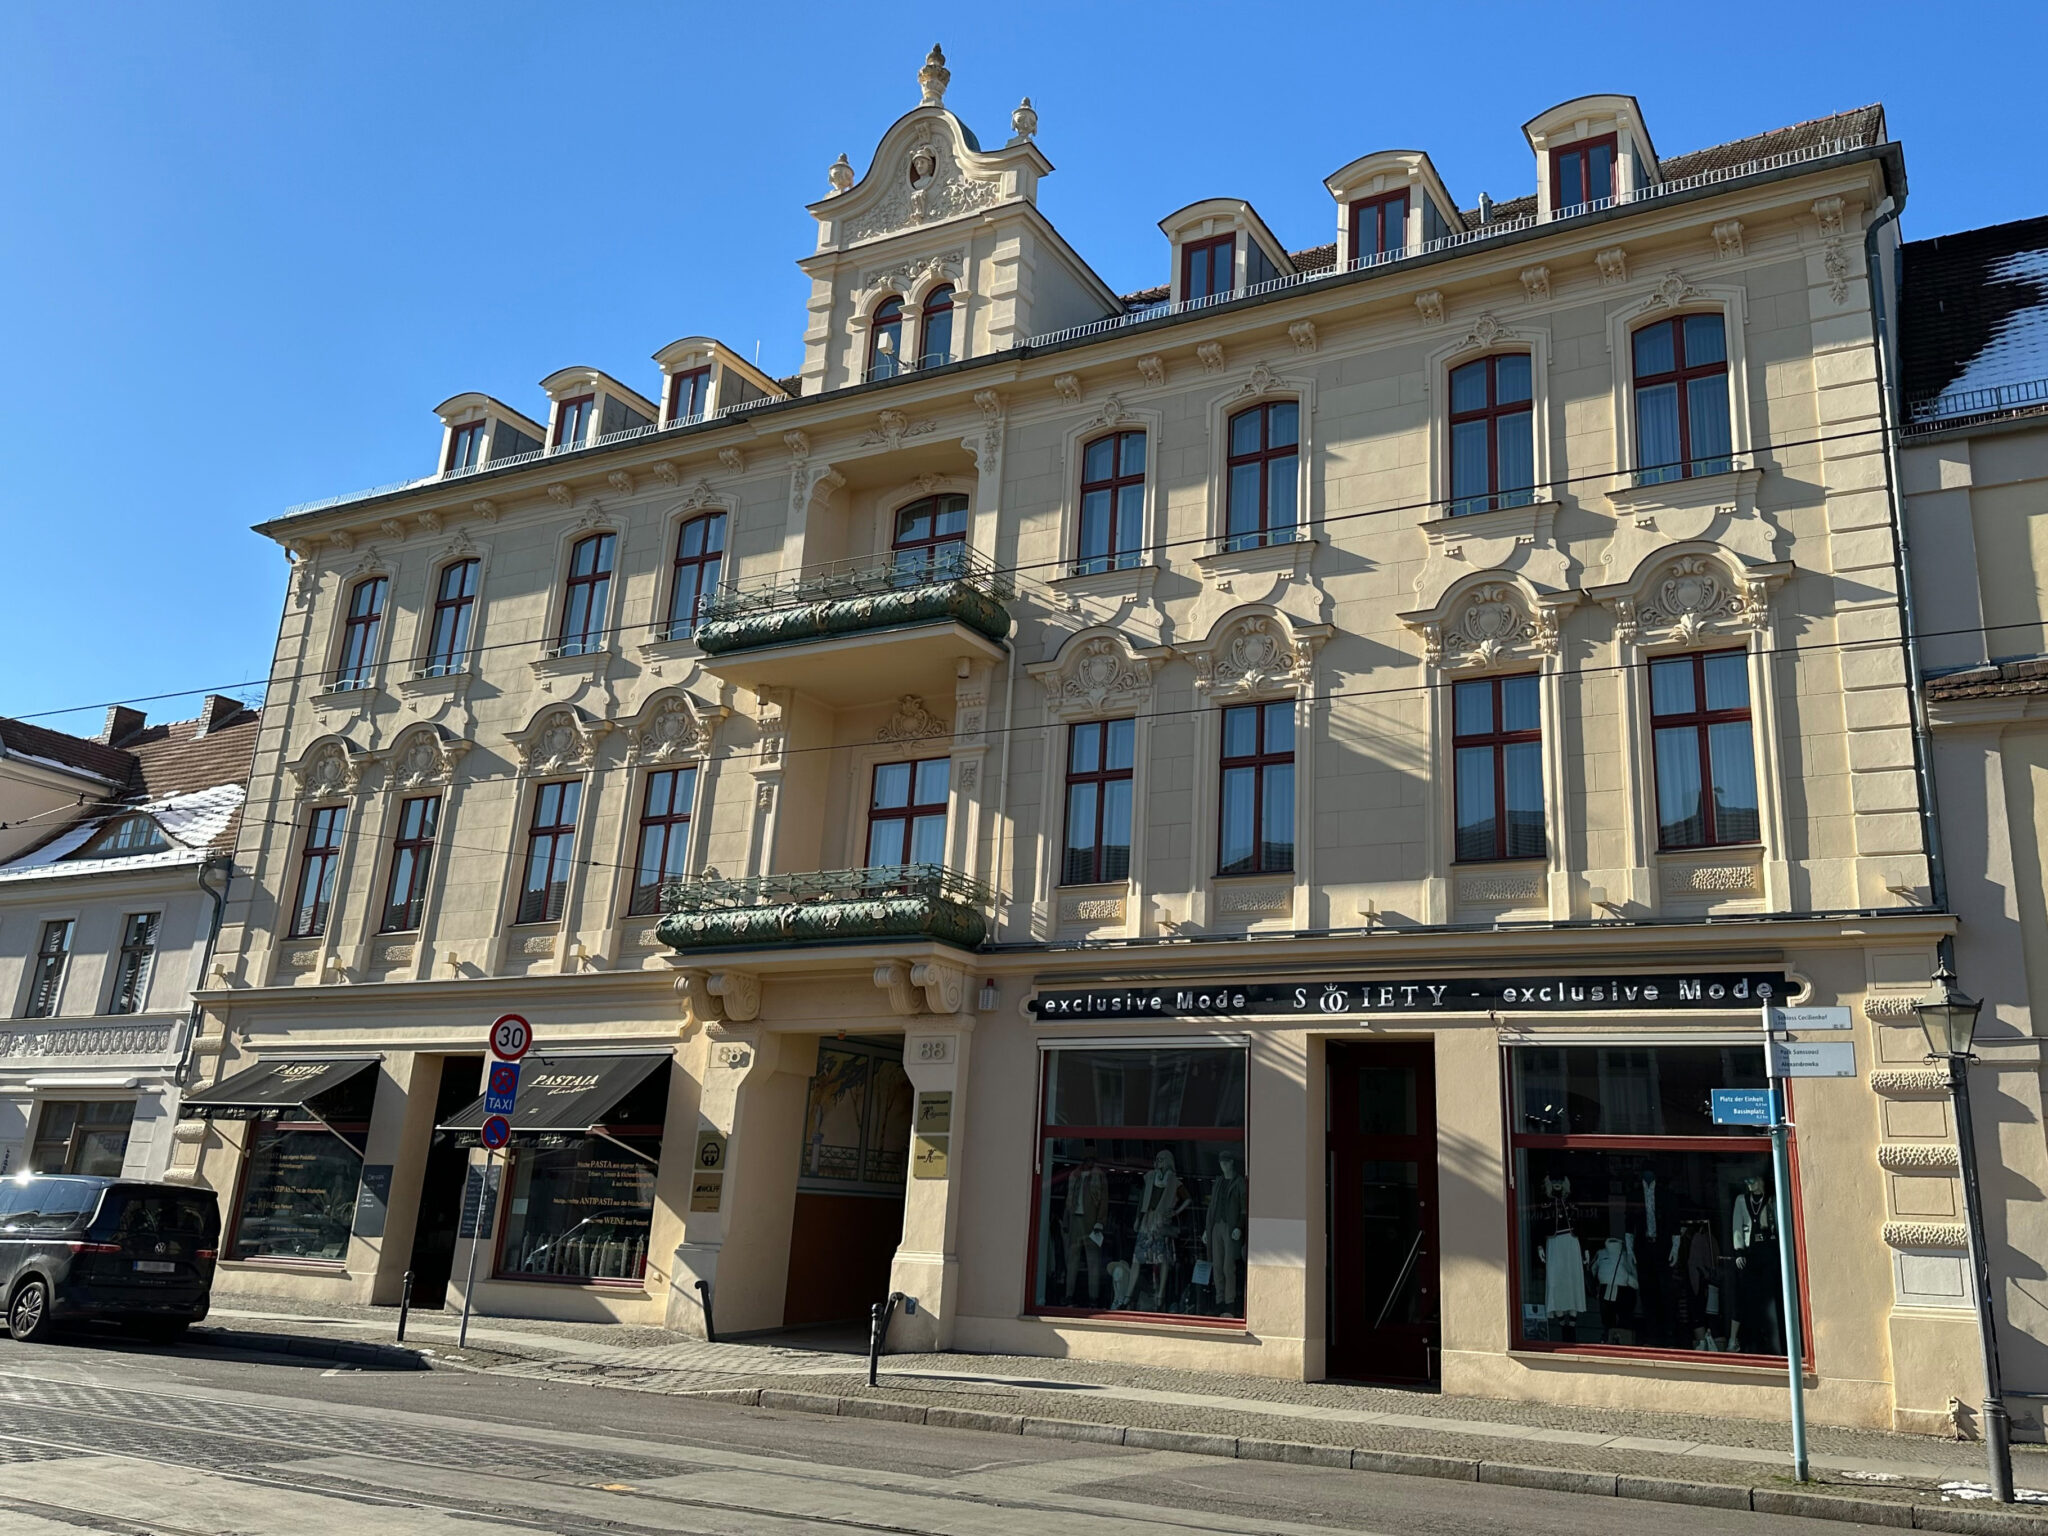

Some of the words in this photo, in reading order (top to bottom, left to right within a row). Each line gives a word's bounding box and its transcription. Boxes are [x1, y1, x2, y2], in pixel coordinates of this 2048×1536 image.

[1044, 993, 1162, 1013] exclusive
[1176, 990, 1246, 1010] Mode
[1502, 980, 1660, 1002] exclusive
[1679, 977, 1773, 1001] Mode
[498, 1026, 524, 1049] 30
[921, 1040, 946, 1060] 88
[530, 1074, 600, 1085] PASTAIA
[488, 1097, 513, 1111] TAXI
[590, 1160, 613, 1168] PASTA
[579, 1197, 613, 1206] ANTIPASTI
[603, 1216, 625, 1225] WEINE
